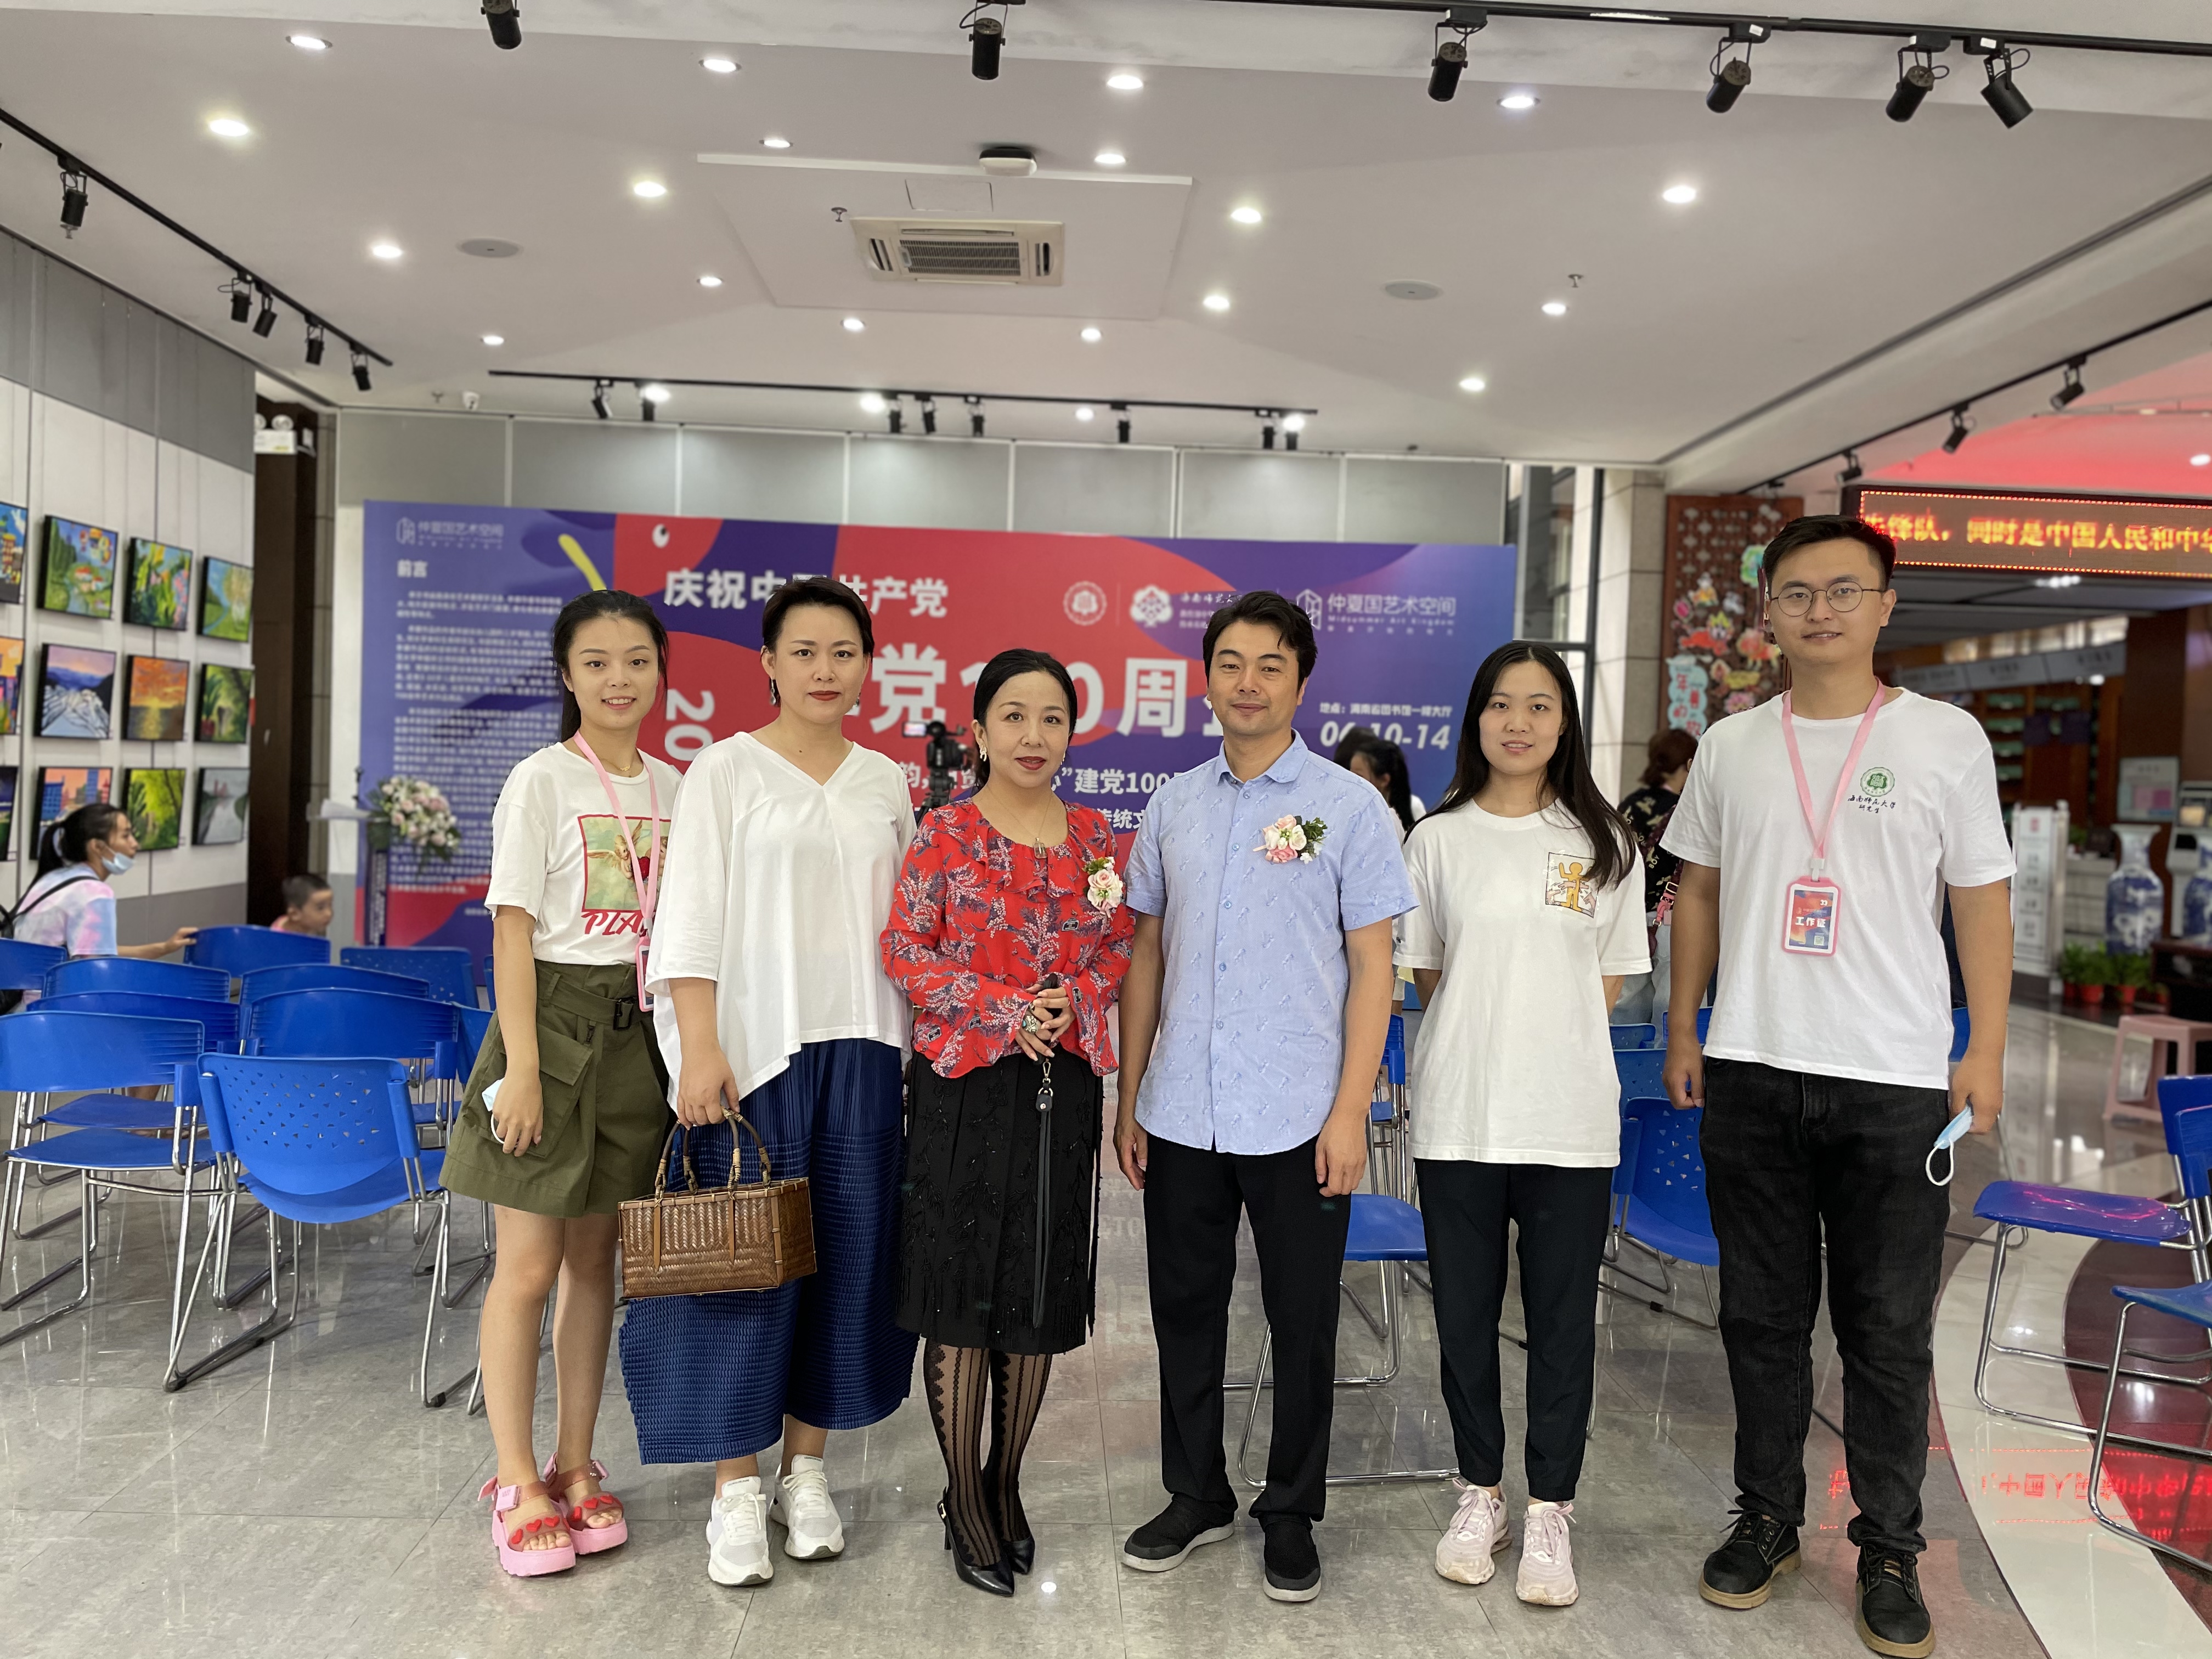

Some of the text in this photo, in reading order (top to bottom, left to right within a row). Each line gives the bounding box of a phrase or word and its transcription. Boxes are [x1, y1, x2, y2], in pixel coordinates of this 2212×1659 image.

[663, 568, 948, 618] 庆祝中共产党
[1328, 593, 1456, 617] 仲夏国艺术空间
[1648, 855, 1660, 869] BOY
[1795, 916, 1826, 928] 工作证
